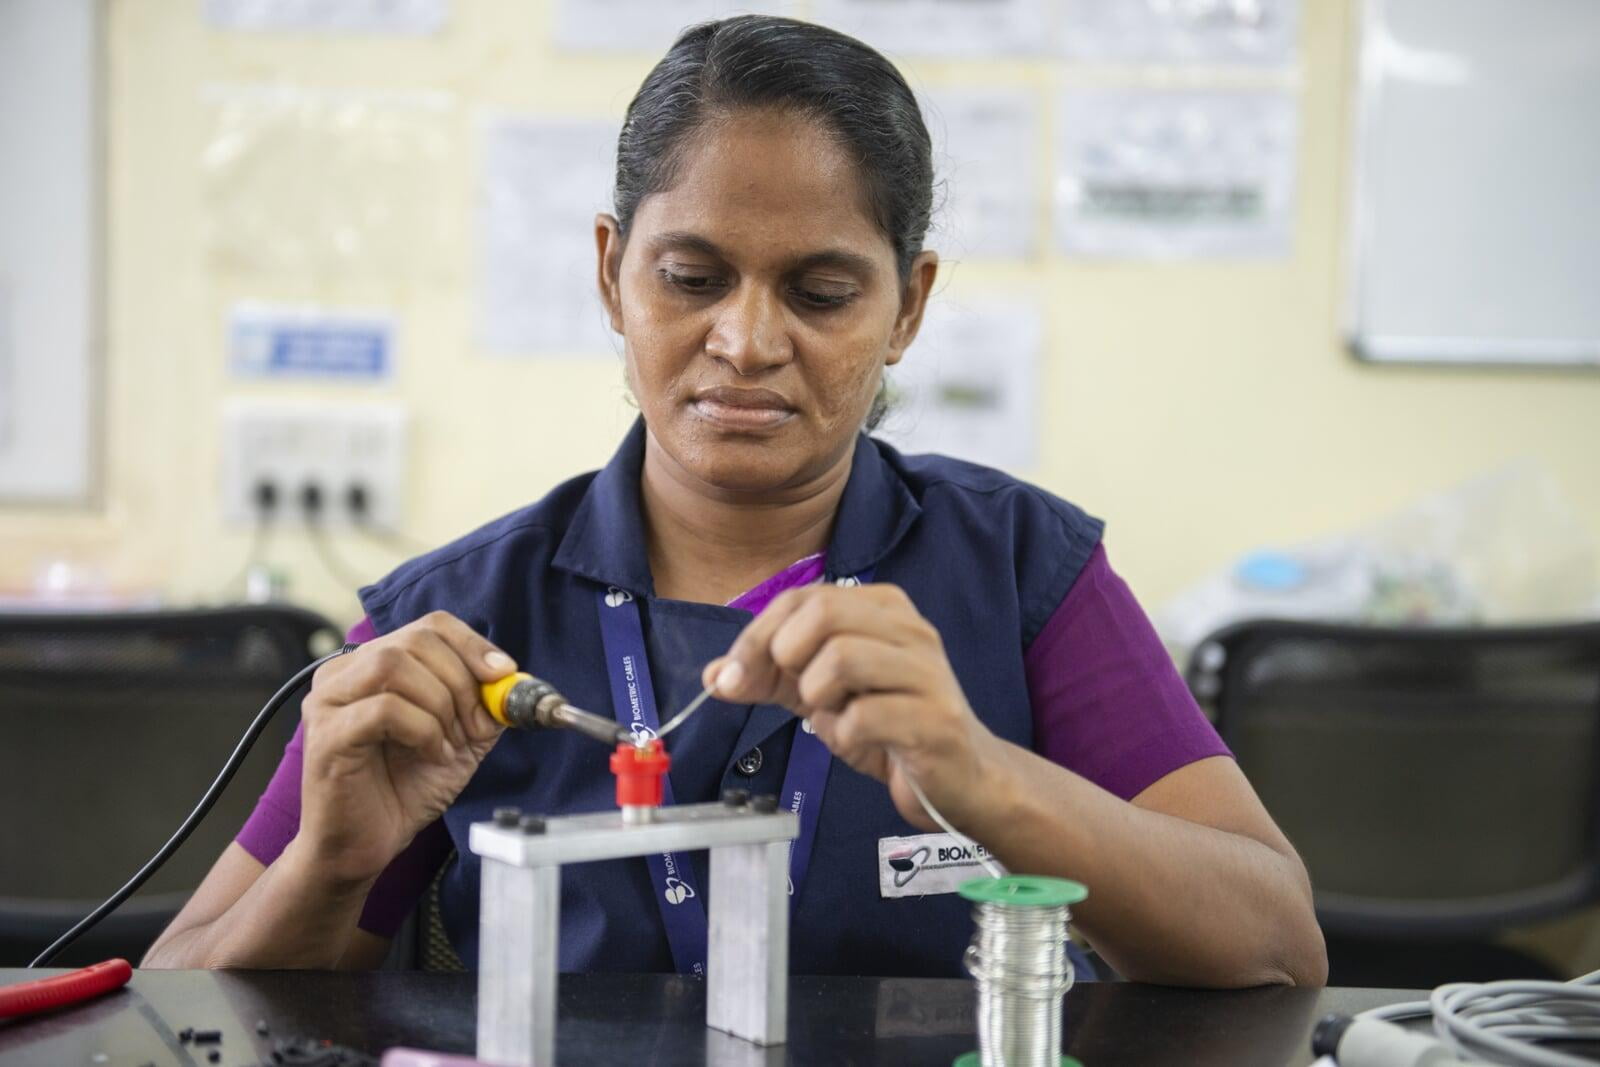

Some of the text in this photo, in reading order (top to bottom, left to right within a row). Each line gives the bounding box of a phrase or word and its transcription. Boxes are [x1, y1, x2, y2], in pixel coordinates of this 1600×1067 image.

[622, 655, 642, 720] BIOMETRIC CABLES
[791, 791, 802, 816] ABLES
[663, 851, 675, 875] BIOM
